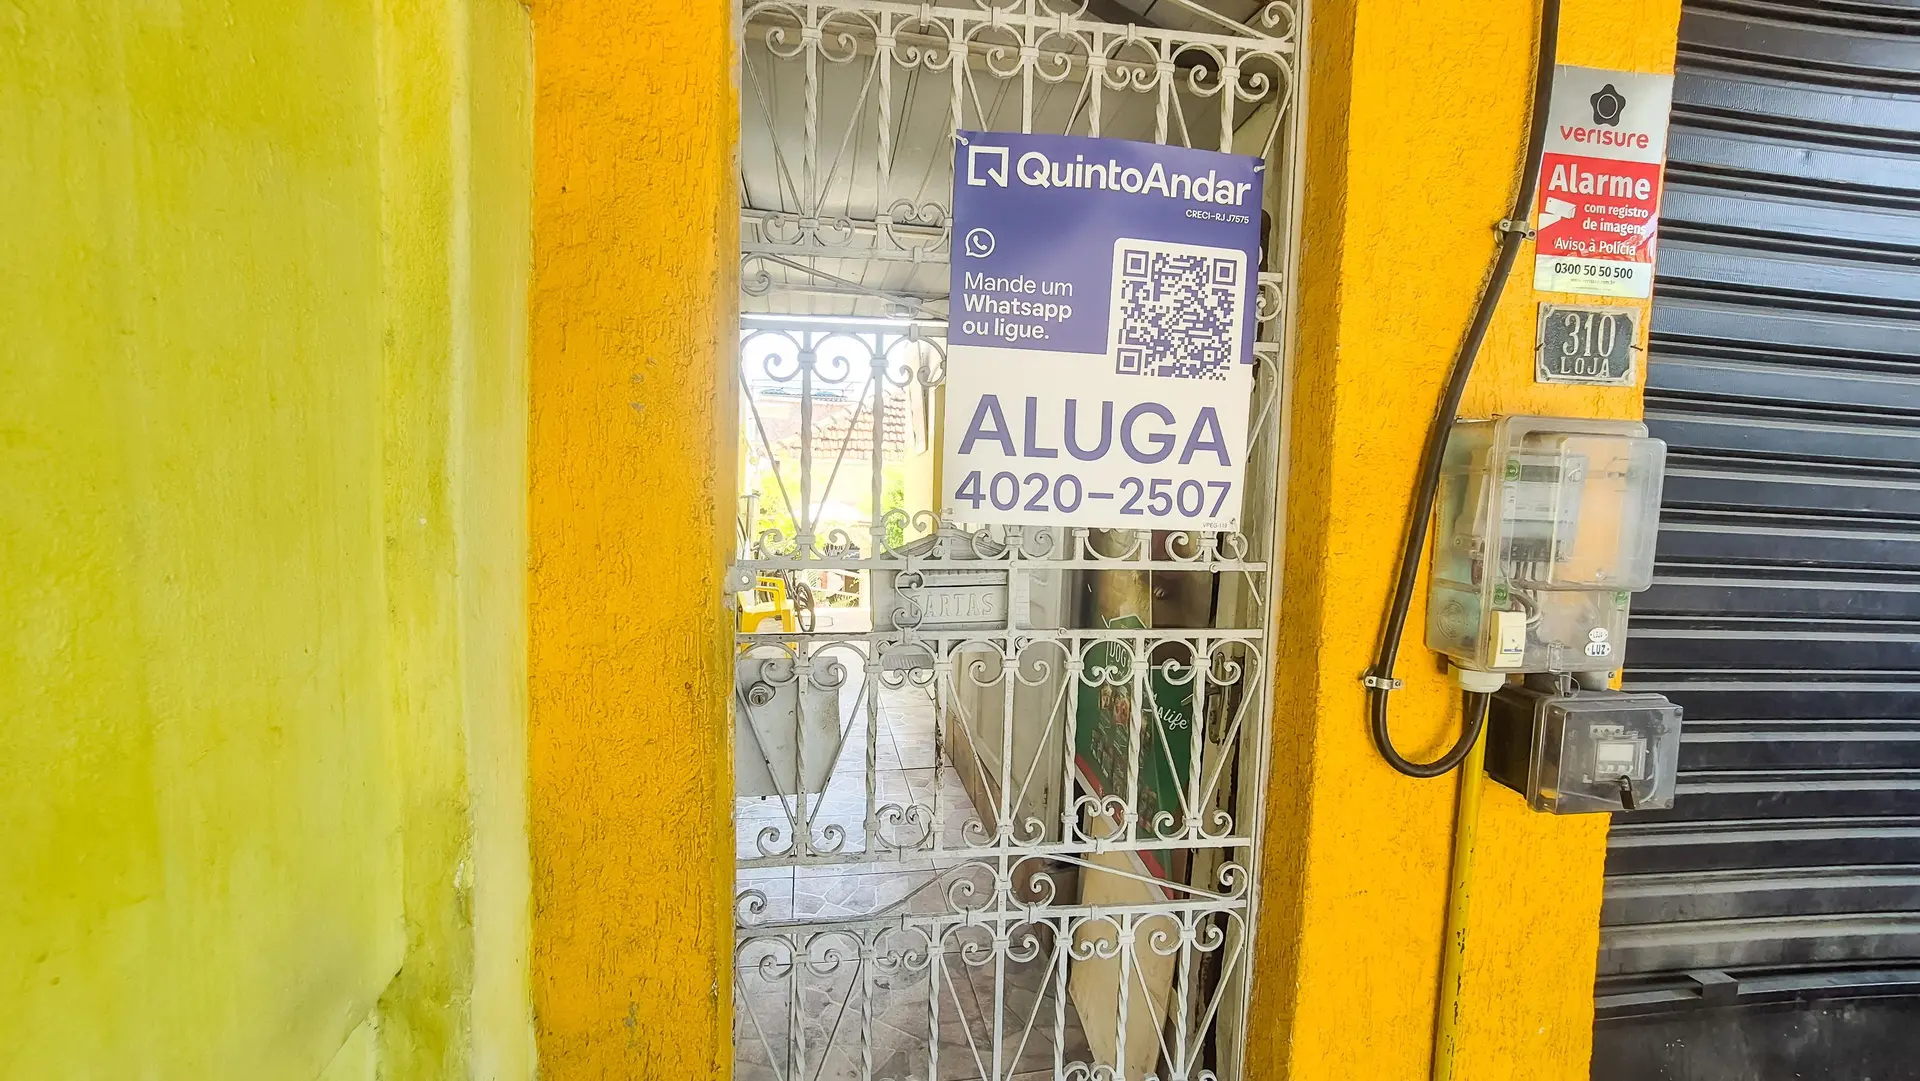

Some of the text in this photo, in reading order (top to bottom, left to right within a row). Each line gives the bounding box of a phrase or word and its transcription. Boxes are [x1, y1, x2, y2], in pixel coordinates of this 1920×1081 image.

[1560, 125, 1649, 149] verisure
[1016, 151, 1251, 206] QuintoAndar
[1548, 164, 1650, 200] Alarme
[1185, 209, 1250, 224] CRECI-RJ J7575
[1584, 203, 1649, 219] com registro
[1582, 218, 1647, 235] de imagens
[1554, 236, 1636, 256] Aviso à Polícia
[1554, 262, 1633, 279] 0300 50 50 500
[964, 272, 1073, 297] Mande um
[963, 294, 1073, 323] Whatsapp
[962, 318, 1050, 342] ou ligue.
[1562, 313, 1616, 357] 310
[1560, 357, 1611, 378] LOJA
[957, 393, 1232, 467] ALUGA
[955, 470, 1232, 518] 4020-2507
[910, 592, 994, 618] CARTAS
[1591, 644, 1606, 655] LUZ
